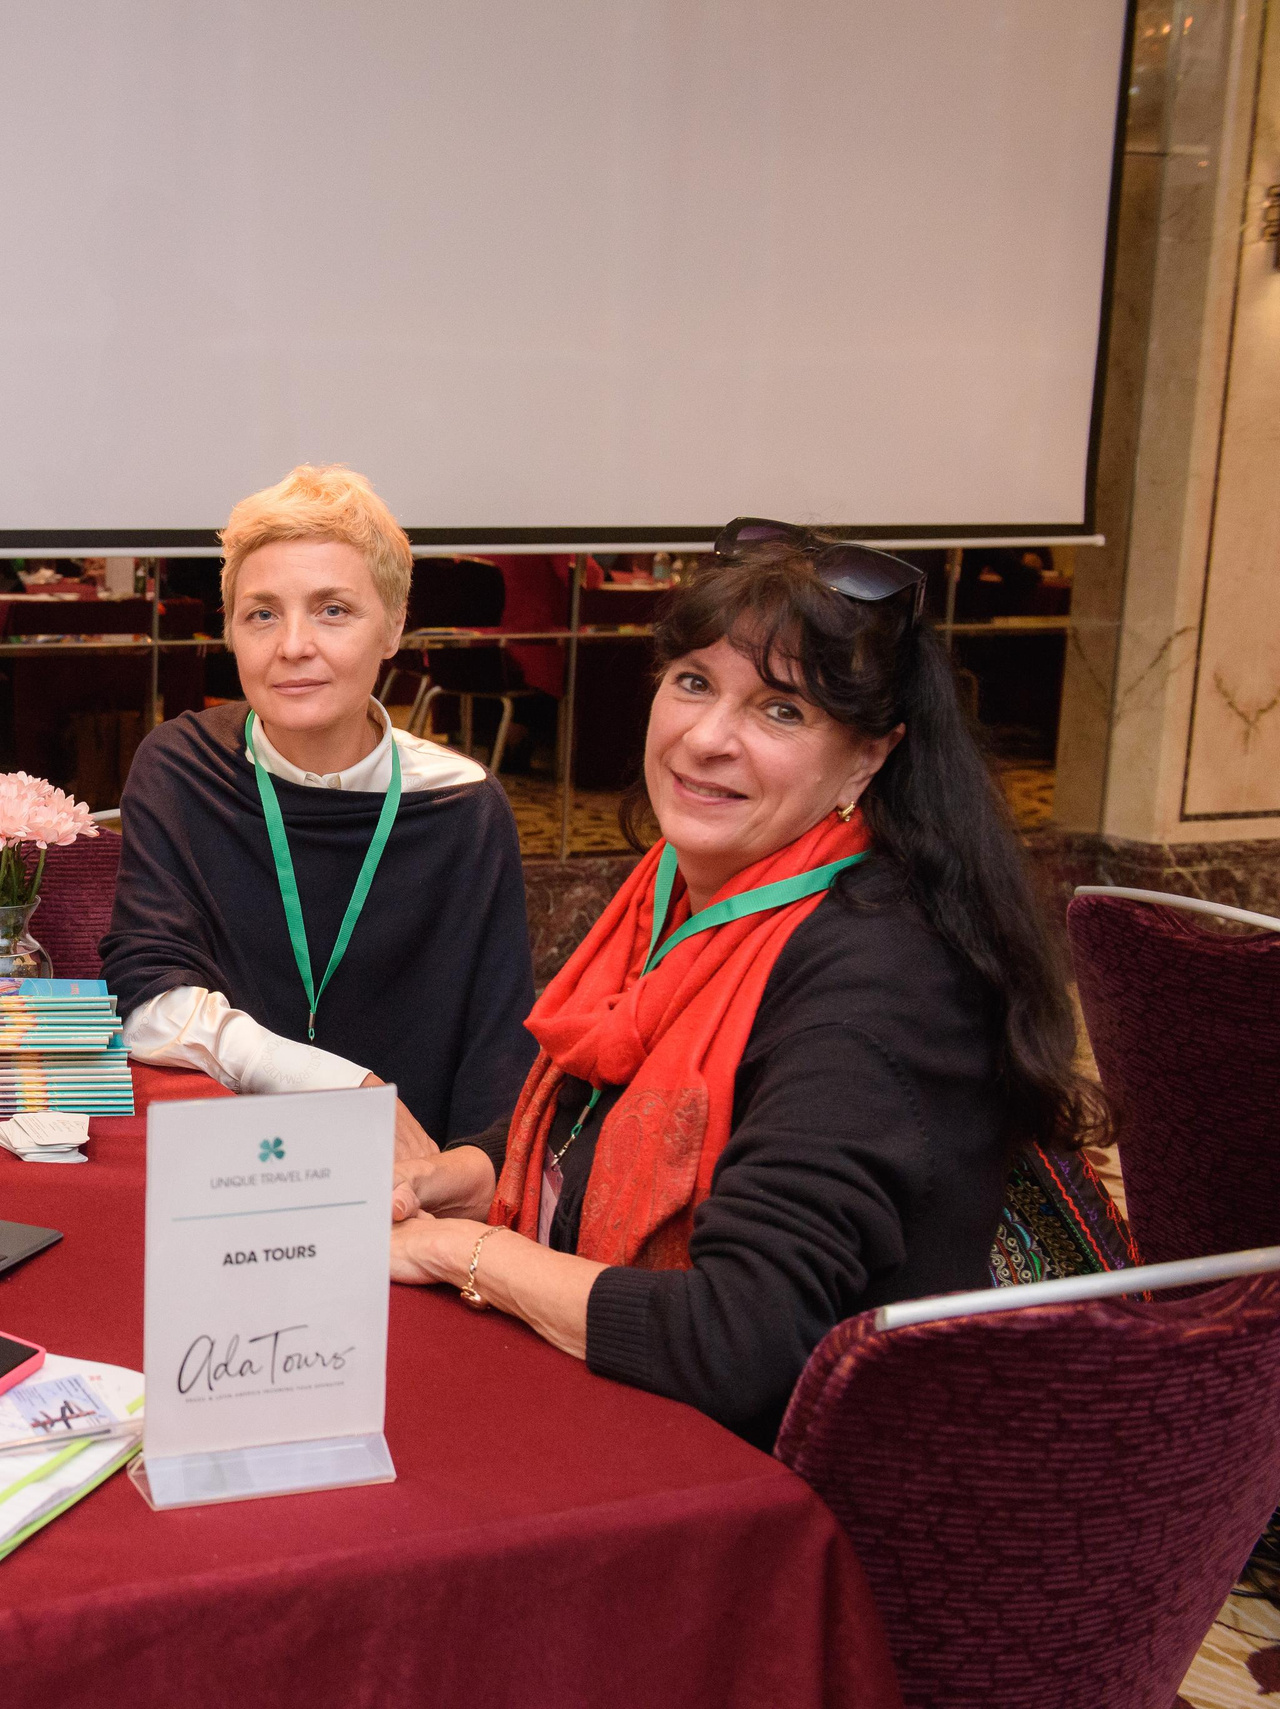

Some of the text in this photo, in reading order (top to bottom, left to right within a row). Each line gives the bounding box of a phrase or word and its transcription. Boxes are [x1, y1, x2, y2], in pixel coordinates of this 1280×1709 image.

[210, 1167, 331, 1189] UNIQUE TRAVEL FAIR
[222, 1244, 317, 1266] ADA TOURS
[248, 1324, 356, 1385] Tours
